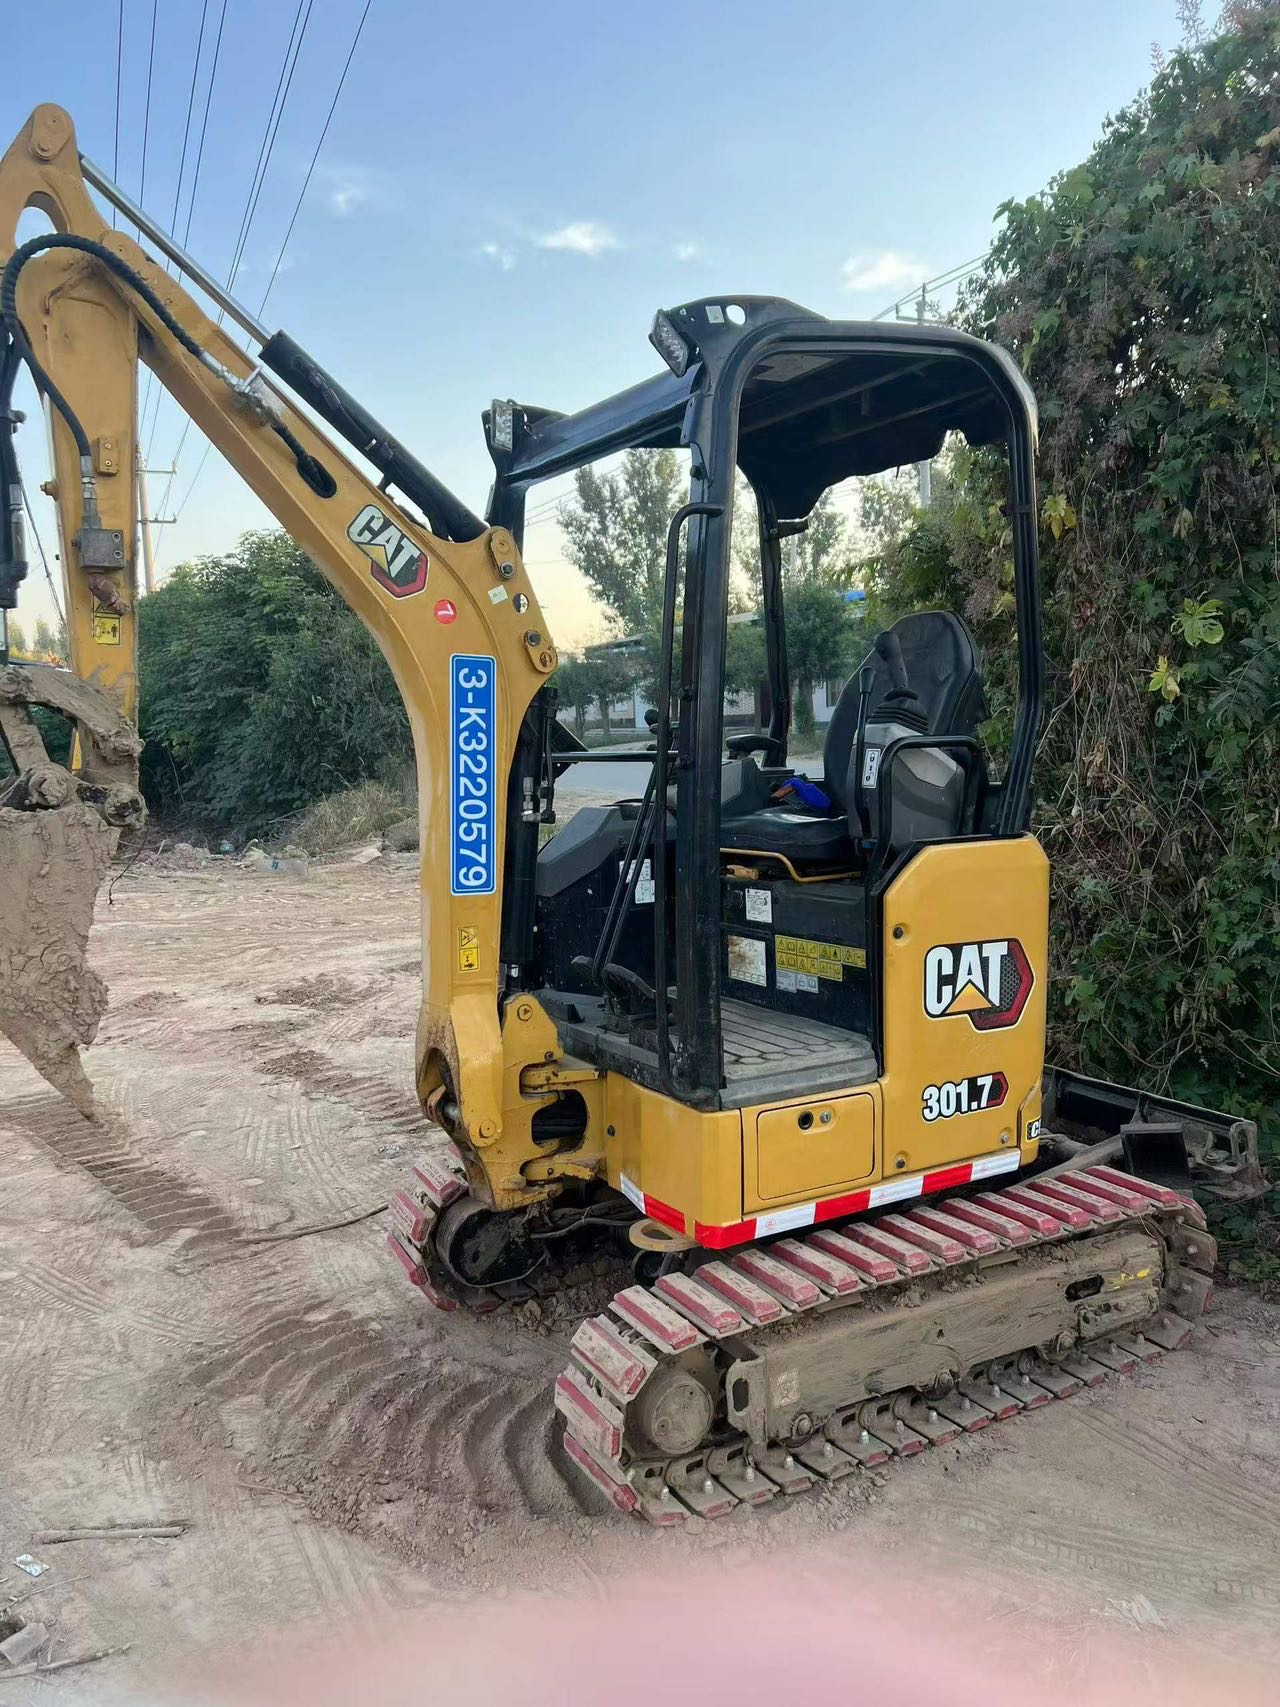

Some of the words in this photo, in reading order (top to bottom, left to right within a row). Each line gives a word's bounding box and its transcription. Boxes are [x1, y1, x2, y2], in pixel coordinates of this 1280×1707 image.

[348, 504, 421, 578] CAT
[458, 667, 488, 887] 3-K3220579
[926, 941, 1008, 1015] CAT
[923, 1075, 994, 1121] 301.7
